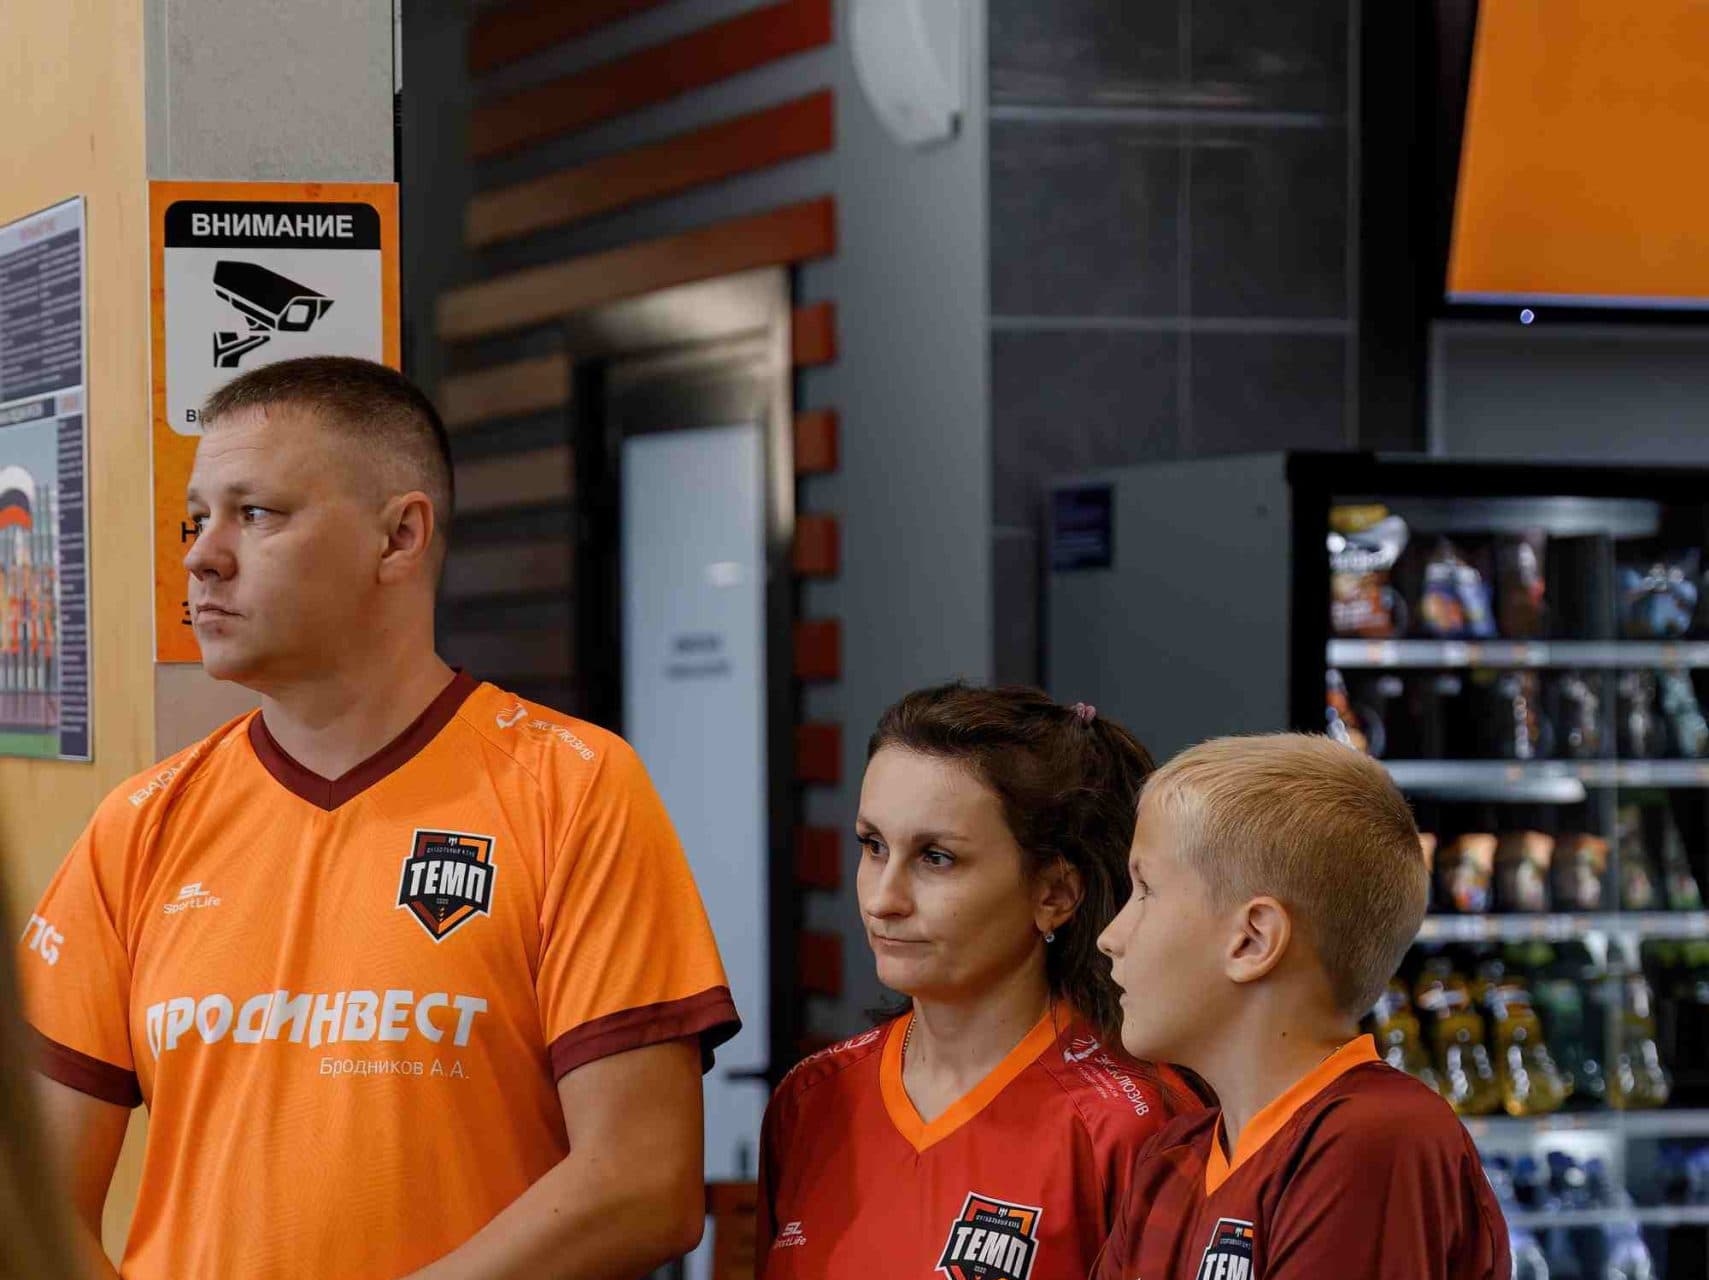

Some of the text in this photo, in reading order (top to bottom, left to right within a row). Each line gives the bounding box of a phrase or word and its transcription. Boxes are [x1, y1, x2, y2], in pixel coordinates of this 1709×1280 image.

[192, 213, 354, 238] ВНИМАНИЕ
[409, 860, 487, 903] ТЕМП
[146, 989, 488, 1063] ПРОДИНВЕСТ
[319, 1057, 424, 1078] Бродников
[950, 1226, 1029, 1279] ТЕМП
